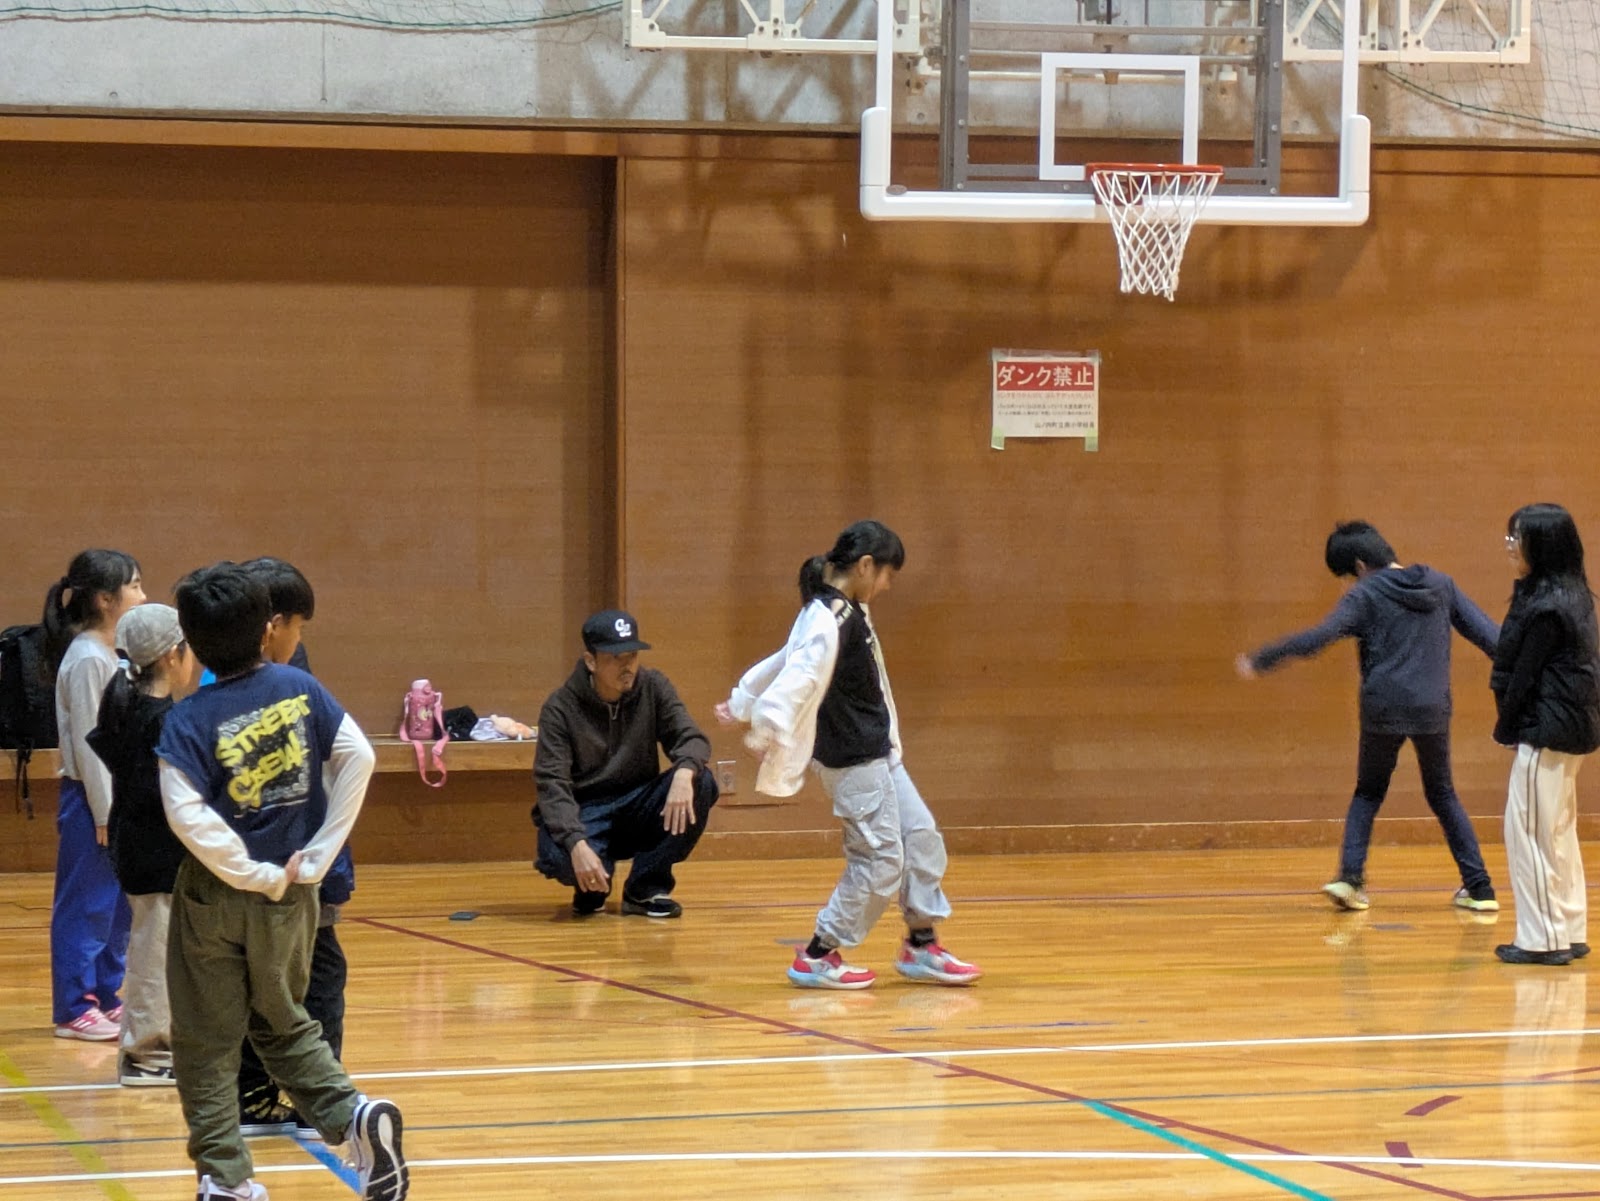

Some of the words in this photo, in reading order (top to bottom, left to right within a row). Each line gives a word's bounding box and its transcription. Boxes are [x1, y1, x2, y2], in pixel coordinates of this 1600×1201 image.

[998, 365, 1093, 387] ダンク禁止
[215, 694, 310, 767] STREET
[228, 729, 310, 807] CREW
